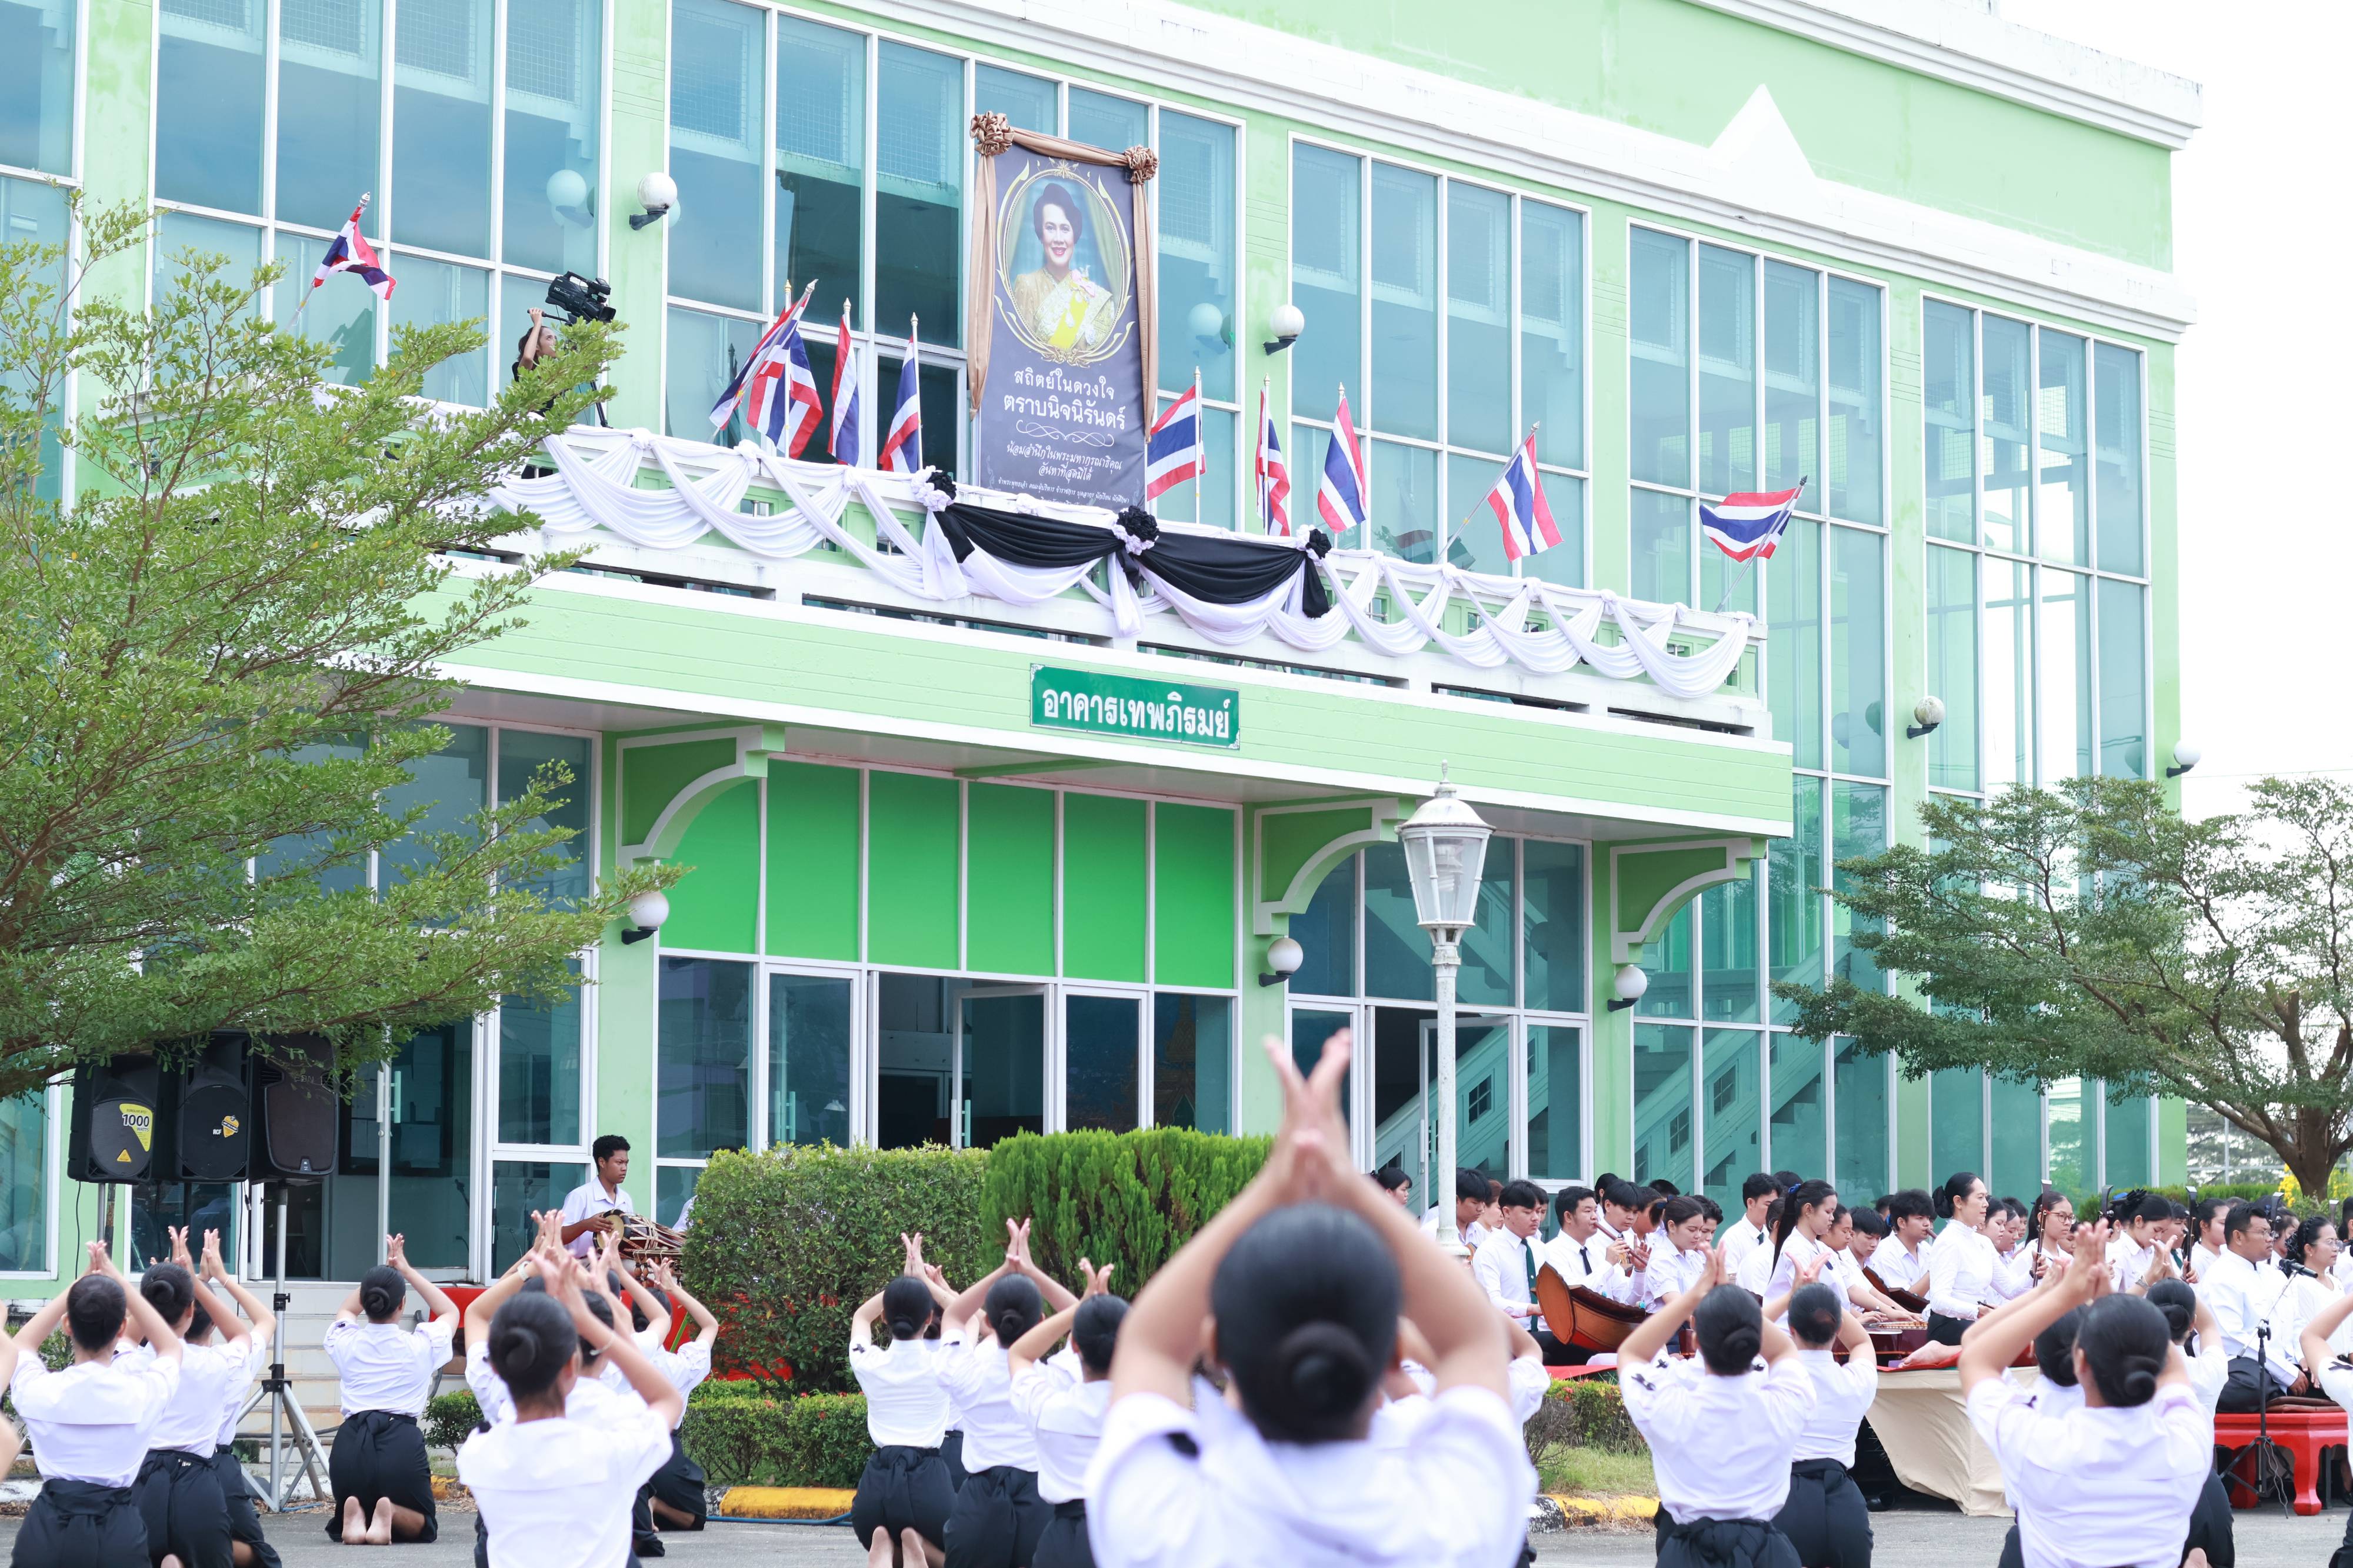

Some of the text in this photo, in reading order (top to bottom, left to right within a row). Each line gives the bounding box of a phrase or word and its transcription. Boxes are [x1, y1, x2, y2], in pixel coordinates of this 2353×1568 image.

[1014, 367, 1115, 400] สถิตย์ในดวงใจ
[1004, 395, 1126, 430] ตราบนิจนิรันดร์
[1042, 689, 1231, 738] อาคารเทพภิรมย์
[122, 1113, 150, 1127] 1000
